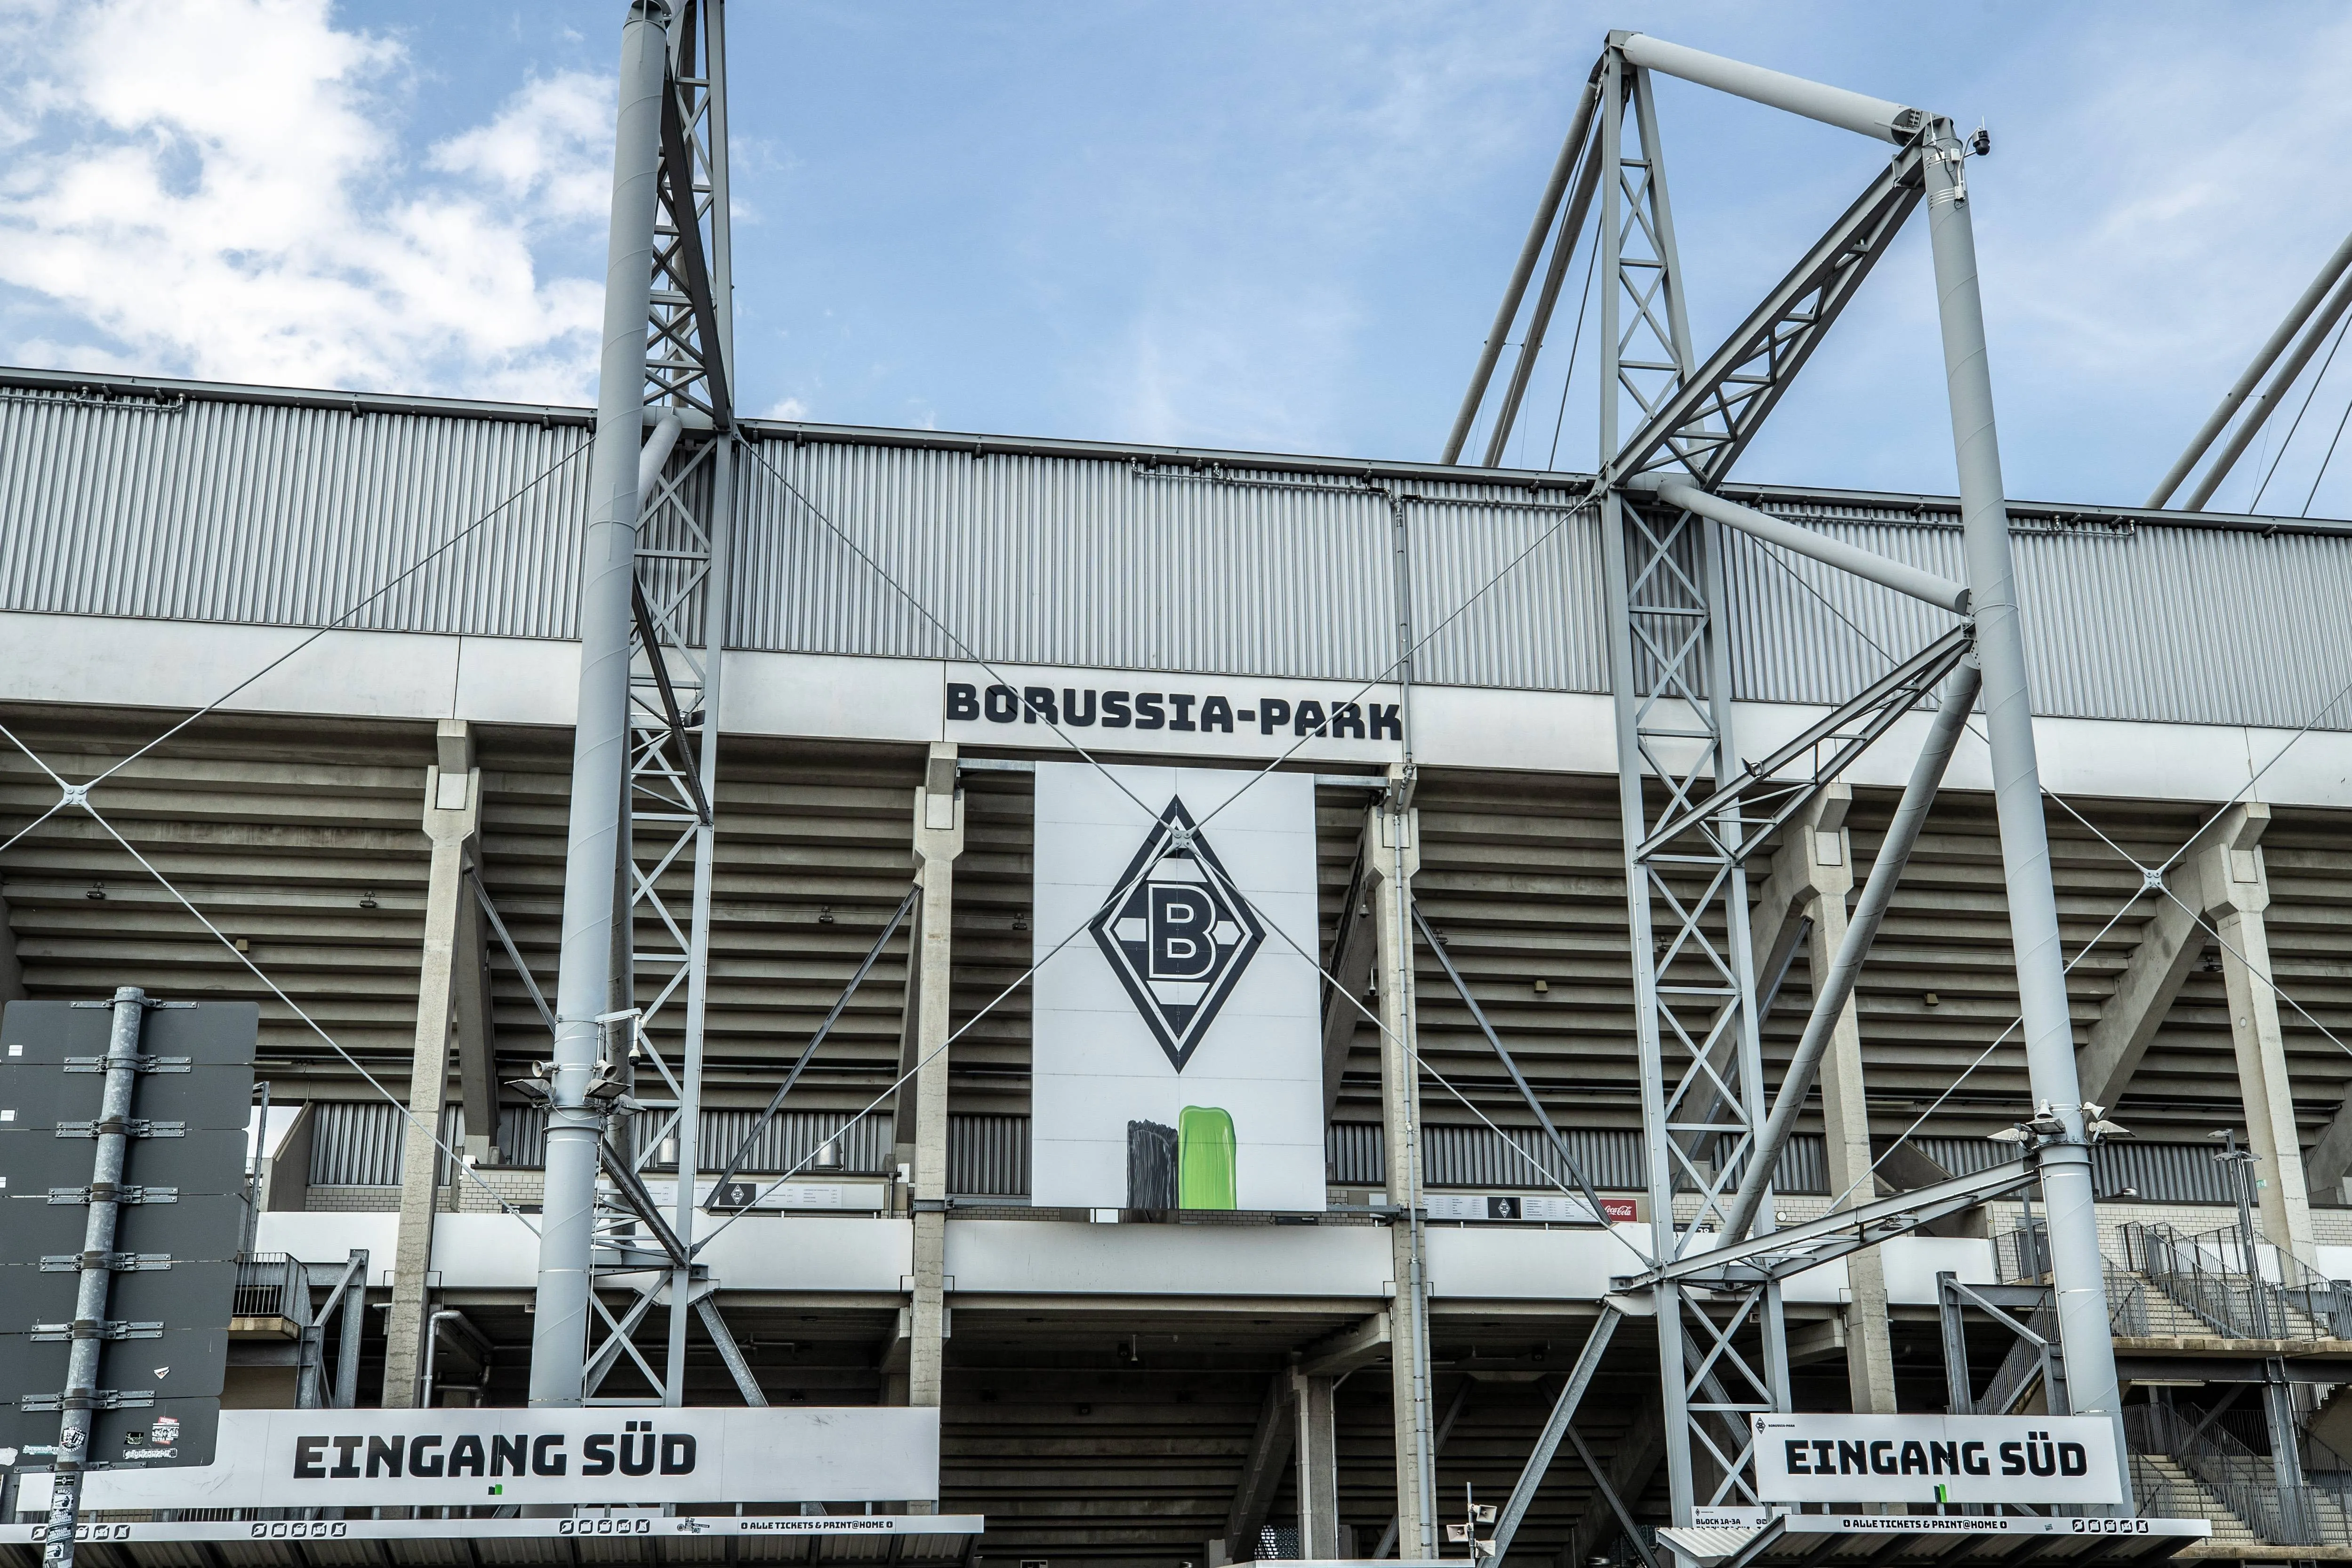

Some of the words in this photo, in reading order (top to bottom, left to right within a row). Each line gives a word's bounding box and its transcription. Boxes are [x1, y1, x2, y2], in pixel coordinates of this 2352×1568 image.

[946, 683, 1403, 741] BORUSSIA-PARK
[1148, 883, 1217, 980] B
[293, 1434, 567, 1479] EINGANG
[581, 1420, 697, 1477] SÜD
[1784, 1439, 1991, 1476] EINGANG
[1999, 1431, 2087, 1477] SÜD
[823, 1520, 884, 1529] PRINT@HOME
[1853, 1520, 1878, 1528] ALLE
[1879, 1520, 1921, 1528] TICKETS
[1923, 1520, 1930, 1528] &
[1932, 1520, 1998, 1529] PRINT@HOME
